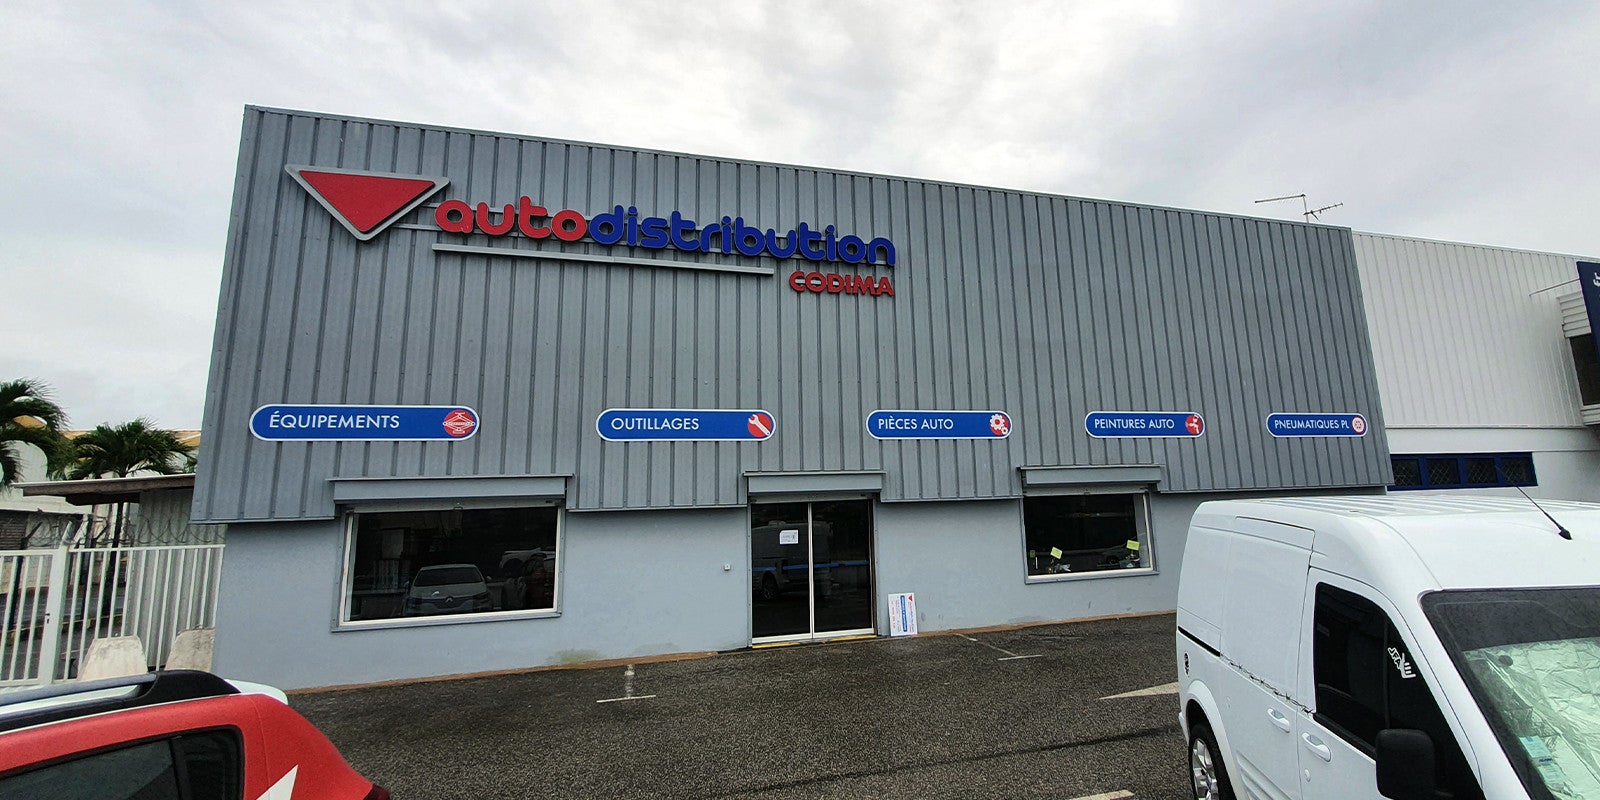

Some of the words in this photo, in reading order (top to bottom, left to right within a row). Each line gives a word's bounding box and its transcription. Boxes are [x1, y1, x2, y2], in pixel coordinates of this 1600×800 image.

[434, 195, 896, 267] autodistribution
[789, 271, 895, 297] CODIMA
[269, 411, 400, 429] ÉQUIPEMENTS
[610, 417, 700, 431] OUTILLAGES
[878, 415, 918, 430] PIÈCES
[921, 418, 954, 430] AUTO
[1094, 418, 1146, 429] PEINTURES
[1148, 418, 1175, 429] AUTO
[1274, 419, 1340, 430] PNEUMATIQUES
[1340, 419, 1350, 429] PL
